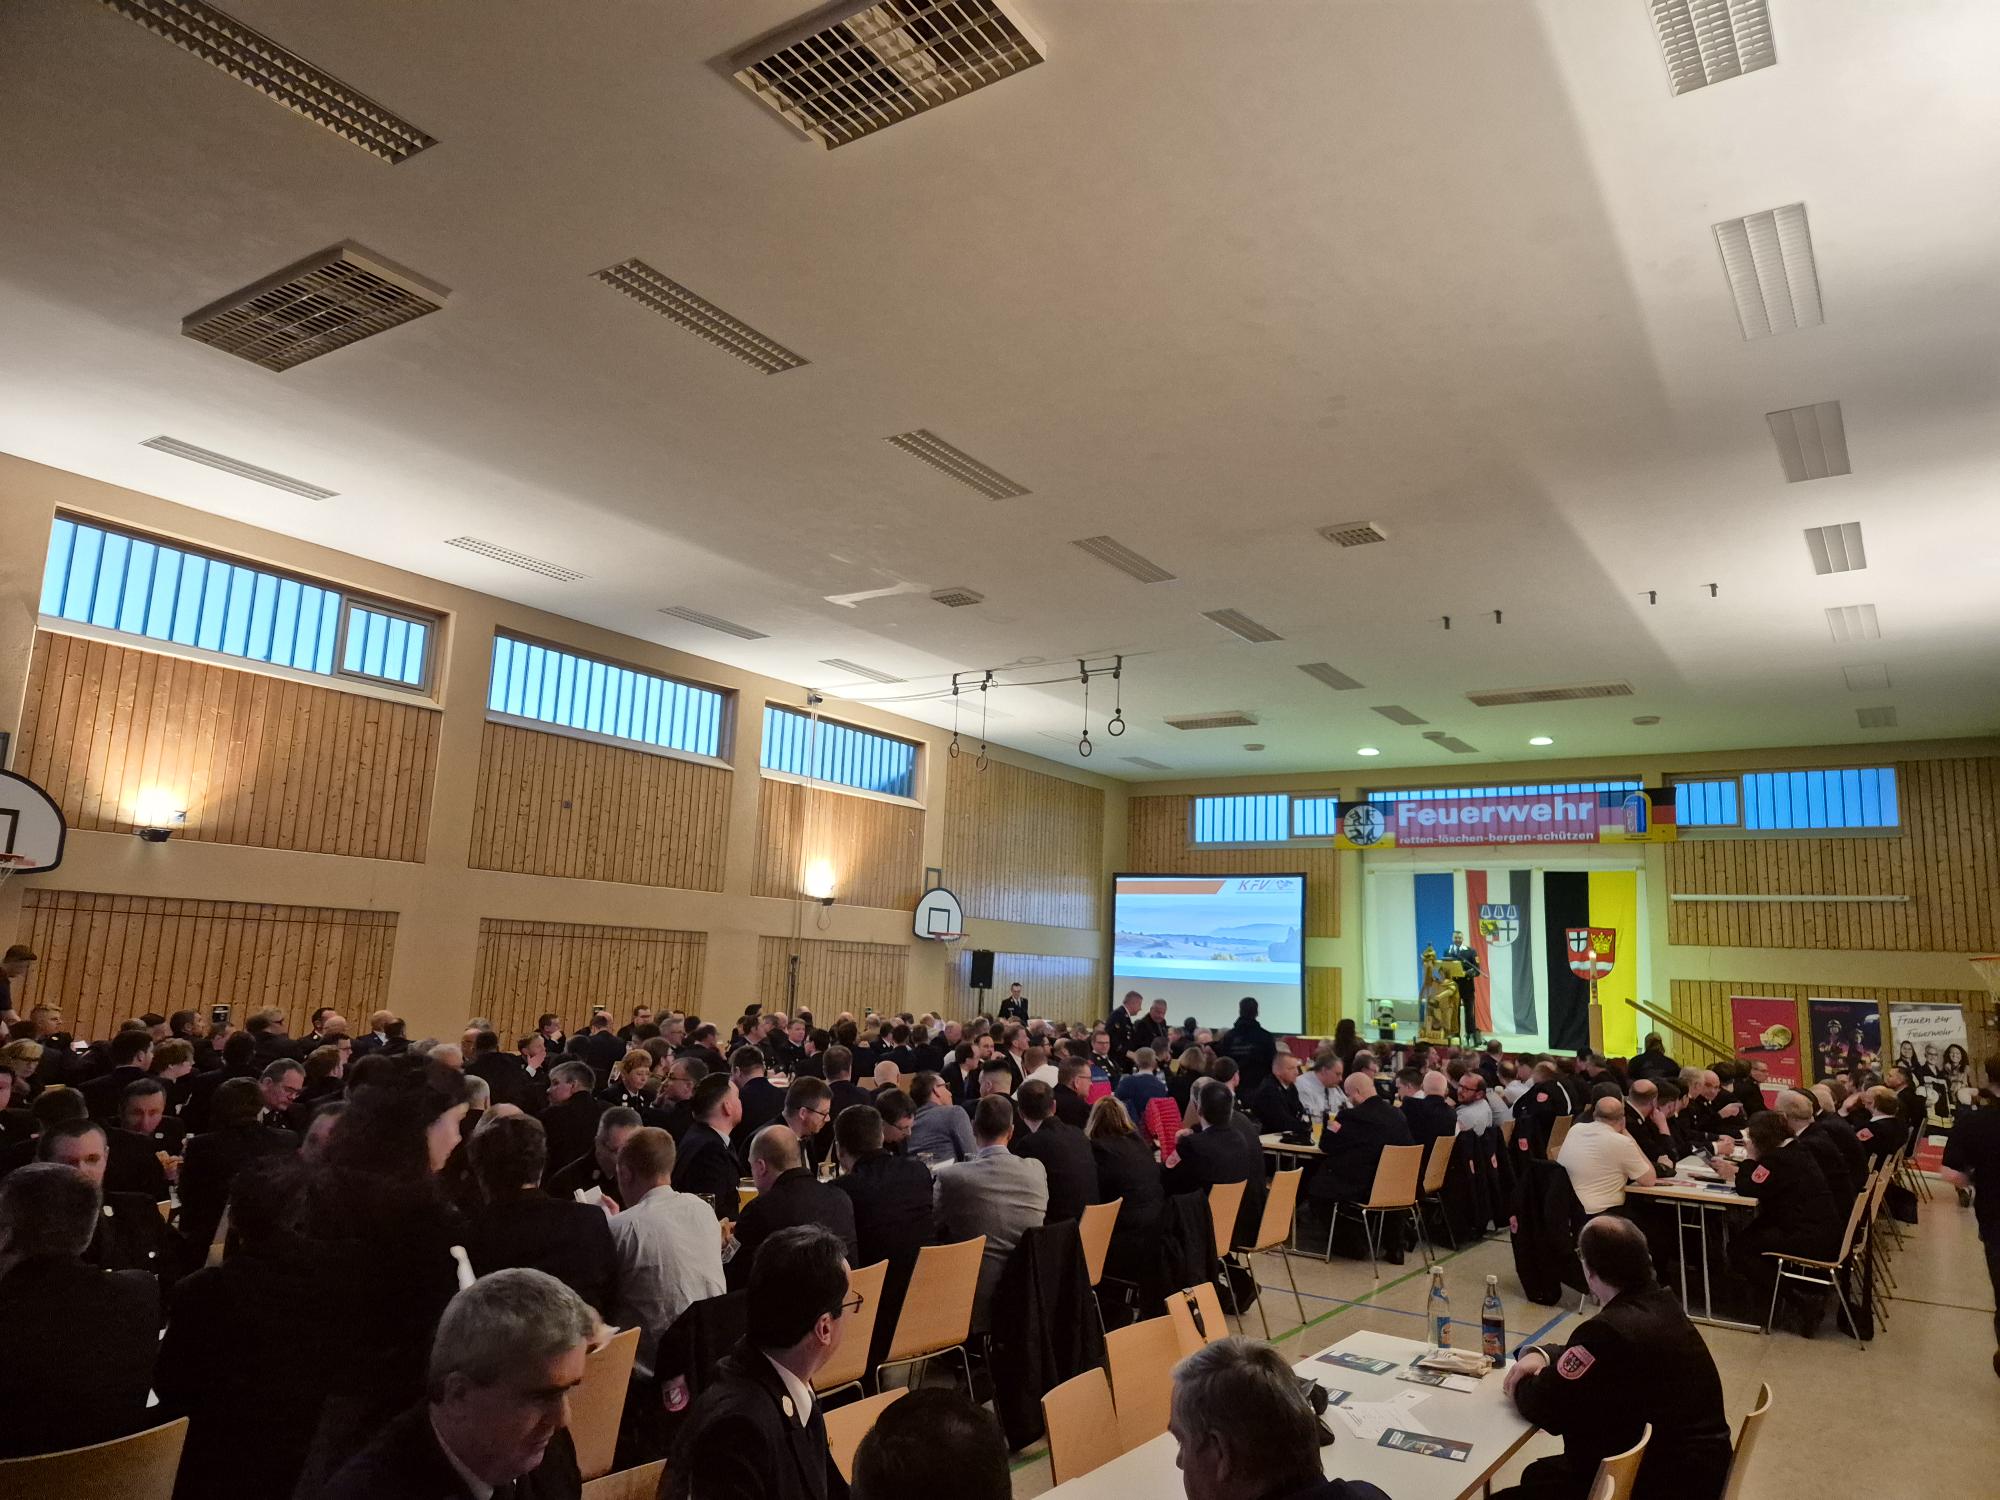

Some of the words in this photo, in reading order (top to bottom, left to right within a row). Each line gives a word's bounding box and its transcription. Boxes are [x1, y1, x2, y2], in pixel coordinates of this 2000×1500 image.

[1398, 796, 1594, 827] Feuerwehr
[1238, 879, 1270, 891] KFV
[1897, 1015, 1931, 1025] Frauen
[1934, 1015, 1952, 1024] zur
[1907, 1027, 1954, 1039] Feuerwehr
